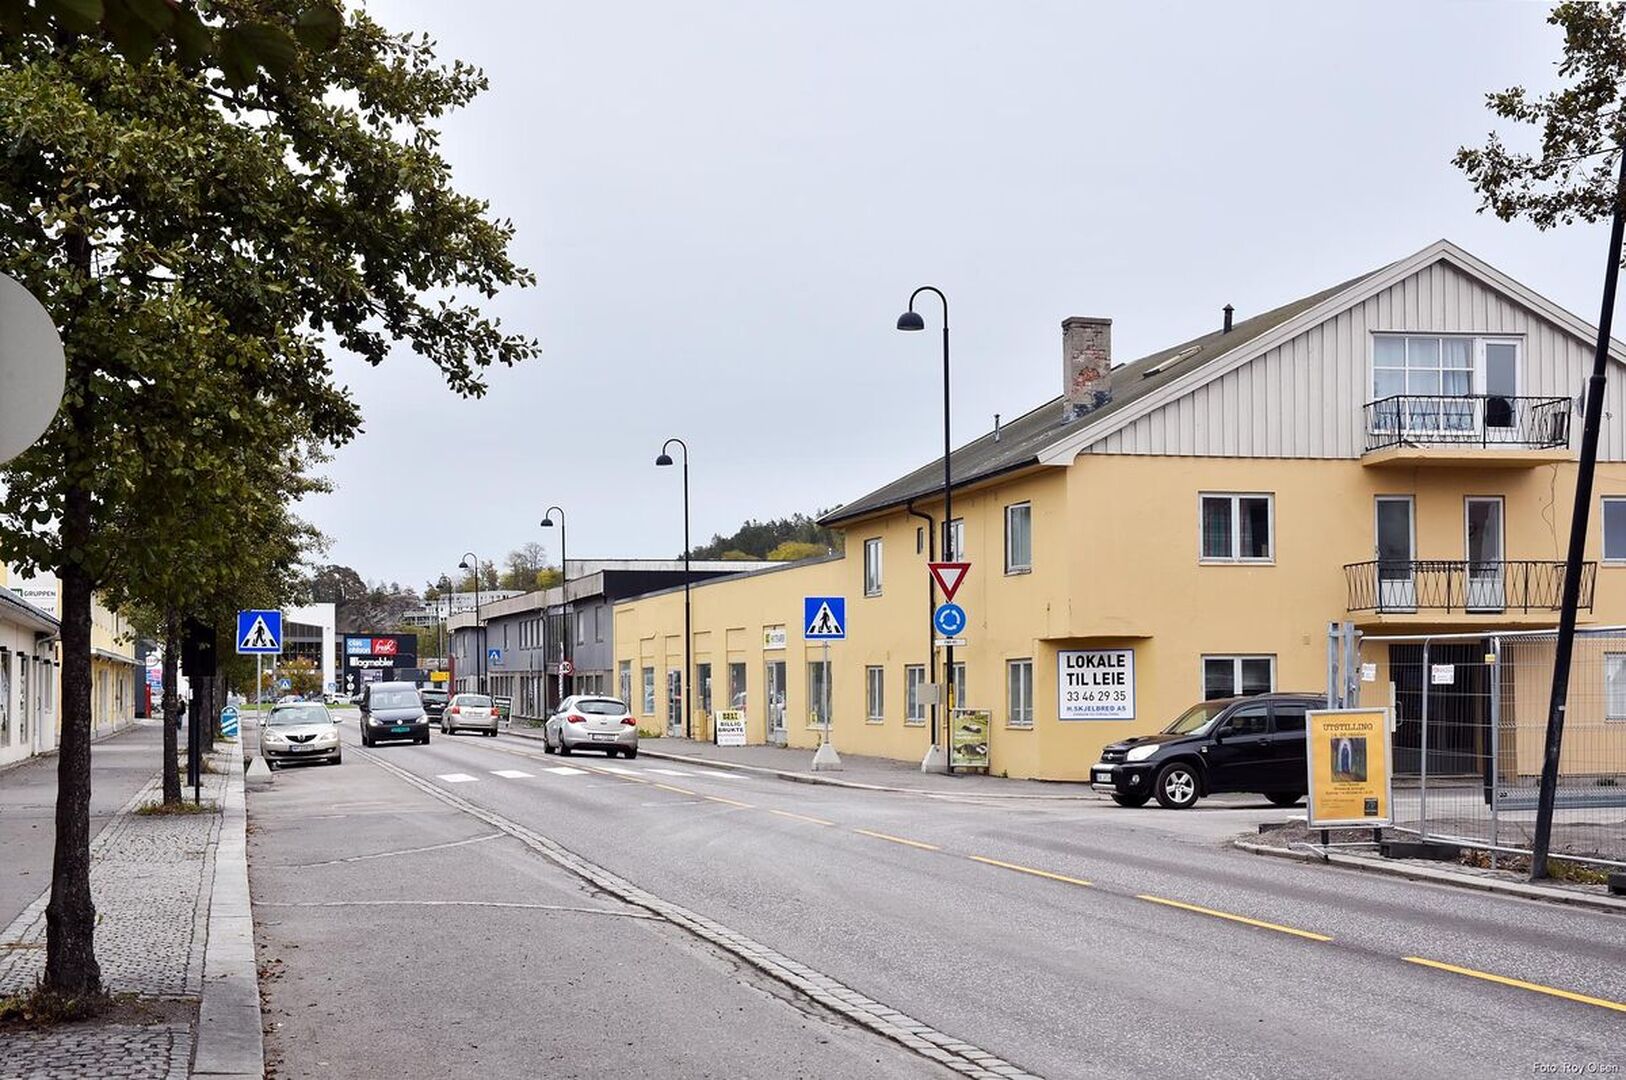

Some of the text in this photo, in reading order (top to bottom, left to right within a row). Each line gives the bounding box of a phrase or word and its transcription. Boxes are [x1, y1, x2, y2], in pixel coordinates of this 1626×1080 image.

[1066, 654, 1126, 669] LOKALE
[1066, 672, 1125, 686] TIL LEIE
[1066, 690, 1127, 702] 33 46 29 35
[1323, 722, 1374, 731] UTSTILLING
